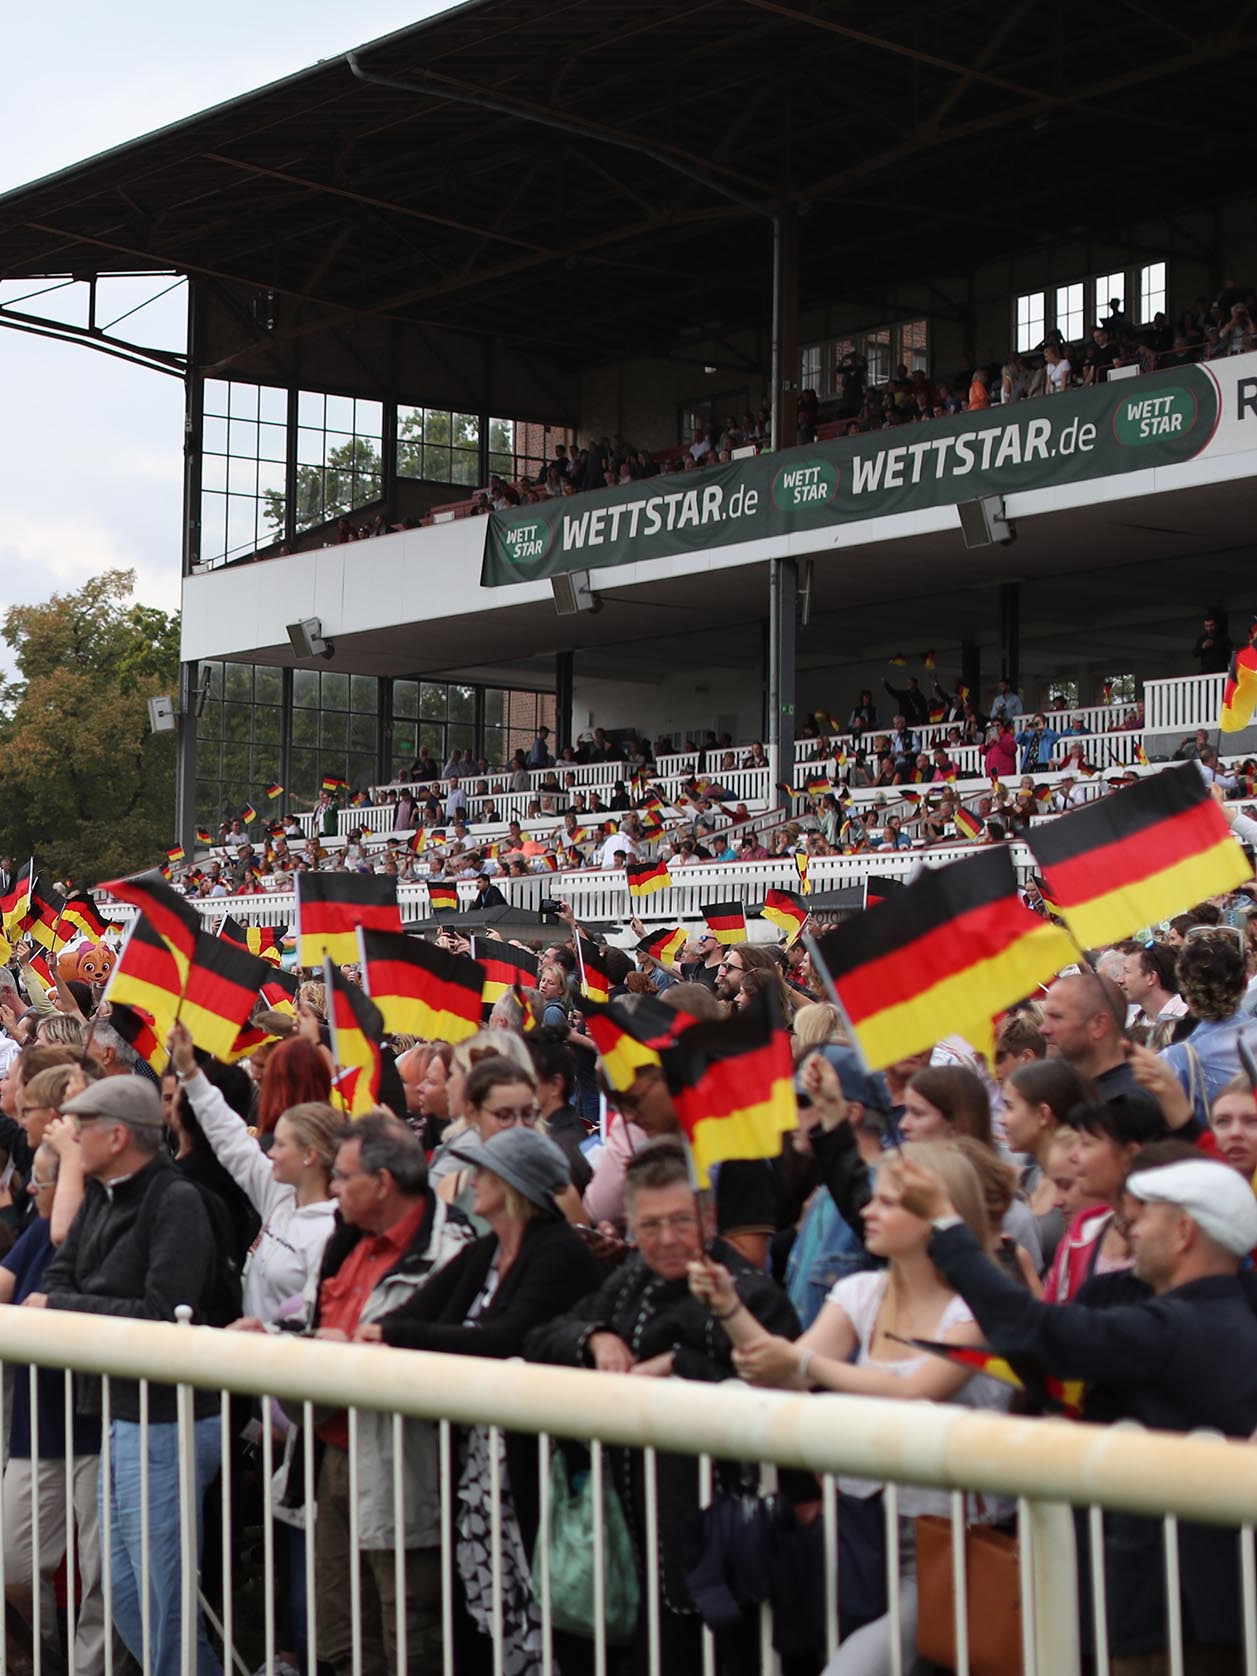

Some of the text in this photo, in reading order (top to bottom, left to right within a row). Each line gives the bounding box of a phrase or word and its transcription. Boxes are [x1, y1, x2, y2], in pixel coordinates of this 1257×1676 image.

[1127, 396, 1175, 421] WETT
[1139, 413, 1183, 438] STAR
[852, 416, 1097, 495] WETTSTAR.de
[783, 466, 821, 488] WETT
[793, 481, 828, 504] STAR
[562, 484, 758, 551] WETTSTAR.de
[506, 525, 538, 545] WETT
[513, 540, 543, 559] STAR
